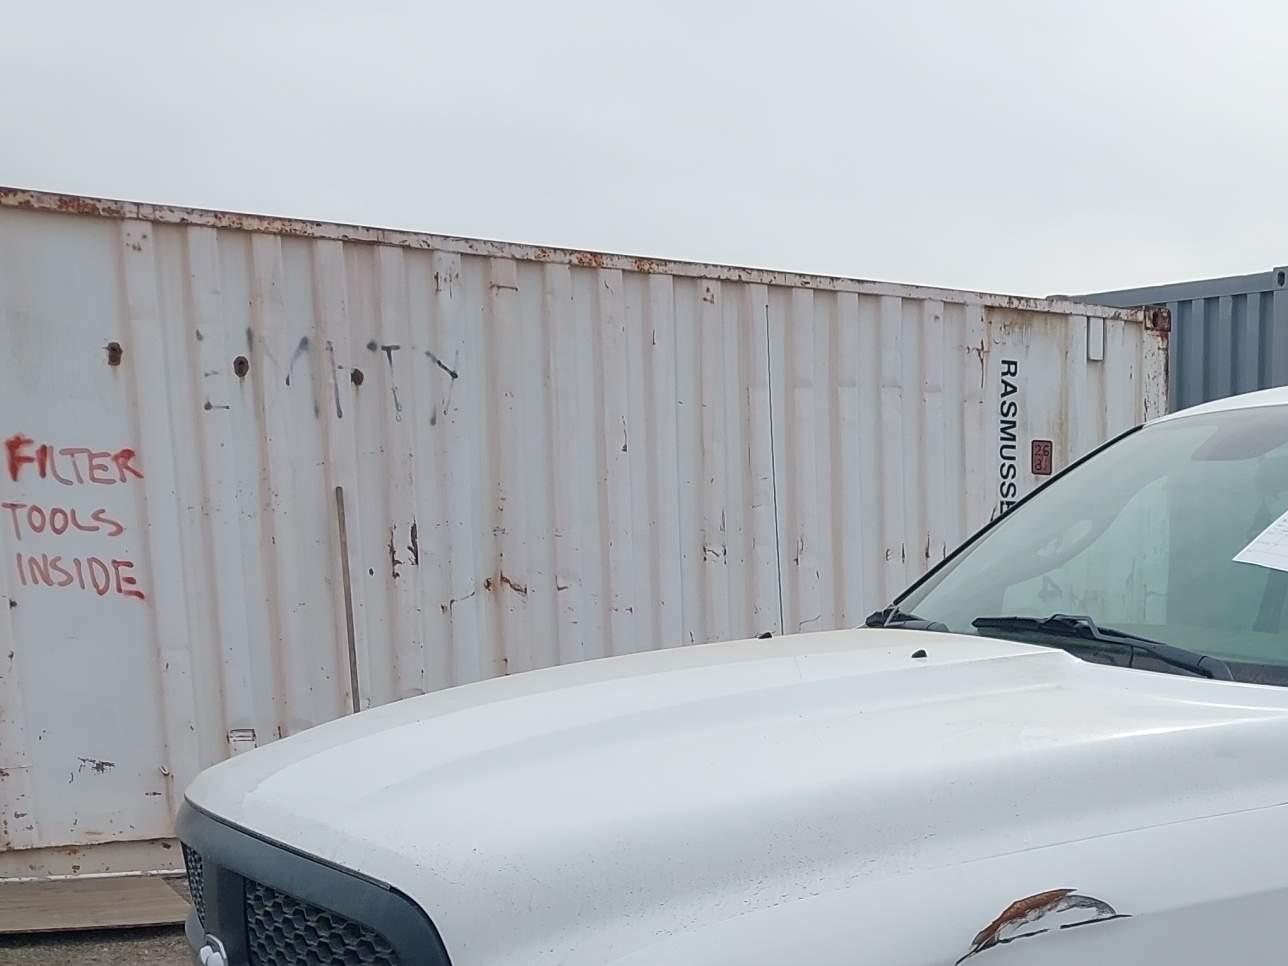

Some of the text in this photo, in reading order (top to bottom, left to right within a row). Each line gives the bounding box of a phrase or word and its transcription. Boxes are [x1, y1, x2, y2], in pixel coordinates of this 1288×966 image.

[5, 434, 144, 486] FILTER
[1, 502, 124, 541] TOOLS
[17, 552, 145, 600] INSIDE
